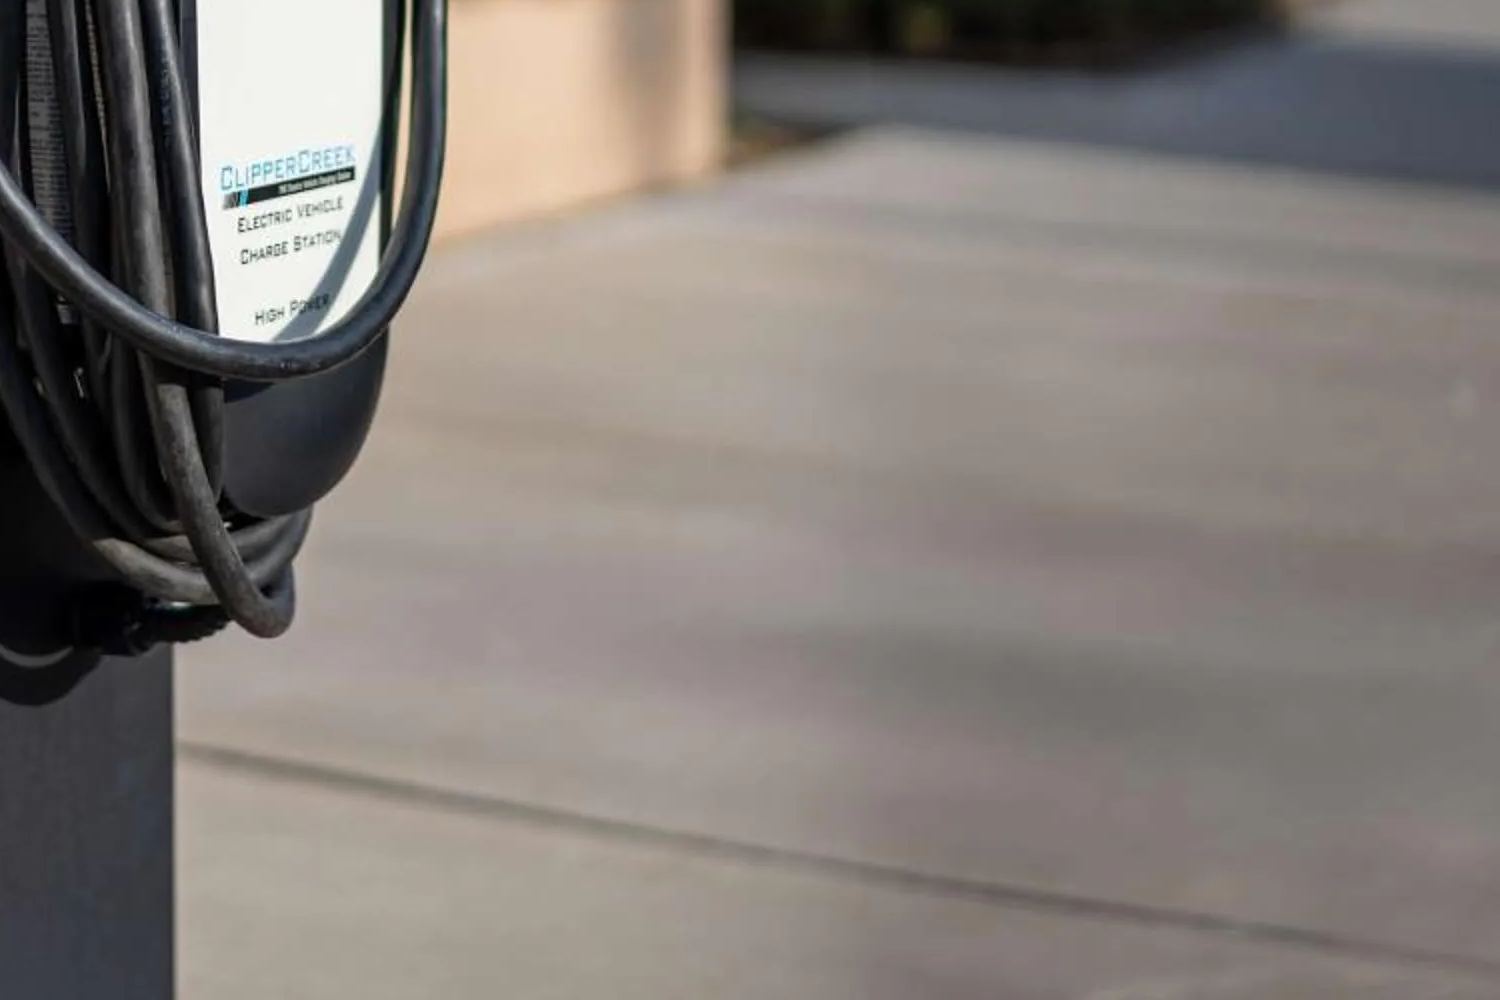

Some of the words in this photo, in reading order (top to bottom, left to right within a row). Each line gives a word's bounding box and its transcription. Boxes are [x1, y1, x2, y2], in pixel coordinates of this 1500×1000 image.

[237, 209, 292, 232] ELECTRIC
[297, 197, 343, 219] VEHICLE
[240, 241, 288, 264] CHARGE
[293, 229, 341, 252] STATION
[255, 306, 285, 326] HIGH
[290, 293, 330, 314] POWER
